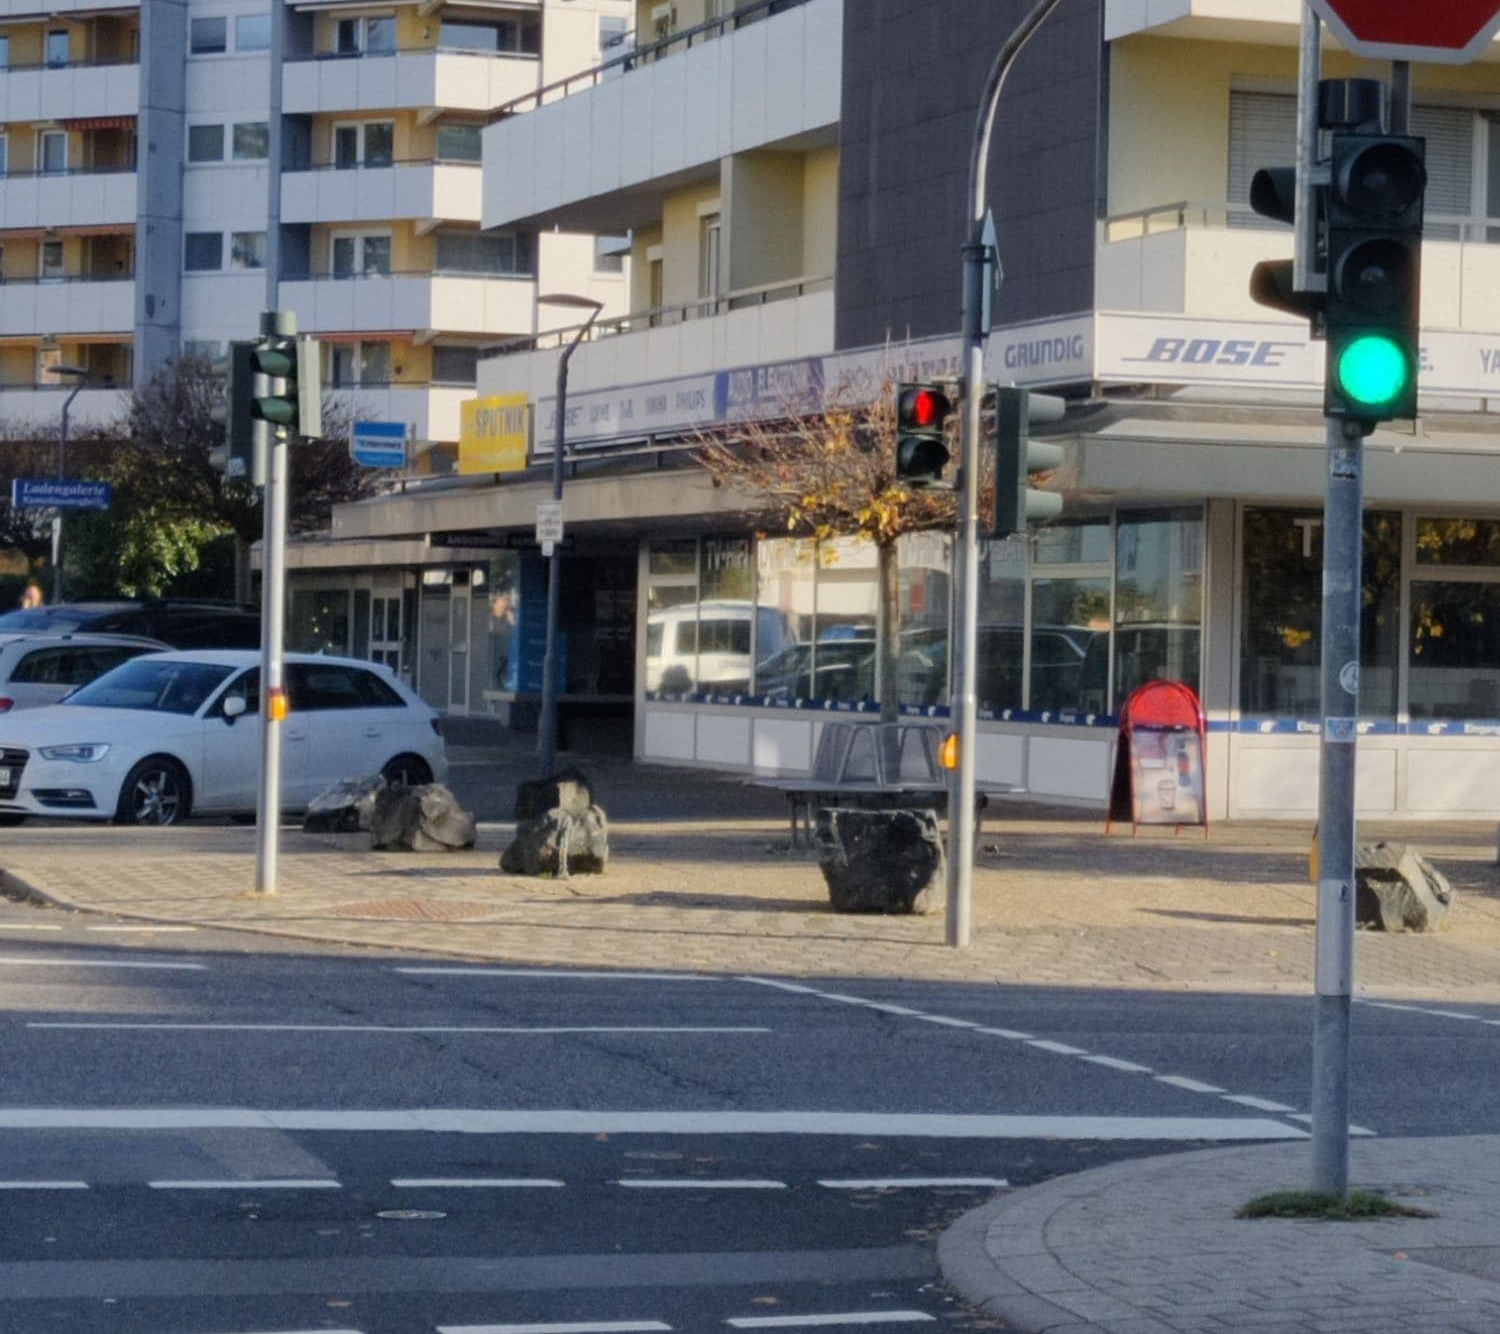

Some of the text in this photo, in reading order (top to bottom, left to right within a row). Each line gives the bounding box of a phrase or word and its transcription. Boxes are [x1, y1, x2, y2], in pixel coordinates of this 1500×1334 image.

[1004, 335, 1083, 369] GRUNDIG
[1140, 337, 1292, 366] BOSE
[475, 404, 526, 437] SPUTNIK
[24, 483, 105, 496] Ladengalerie
